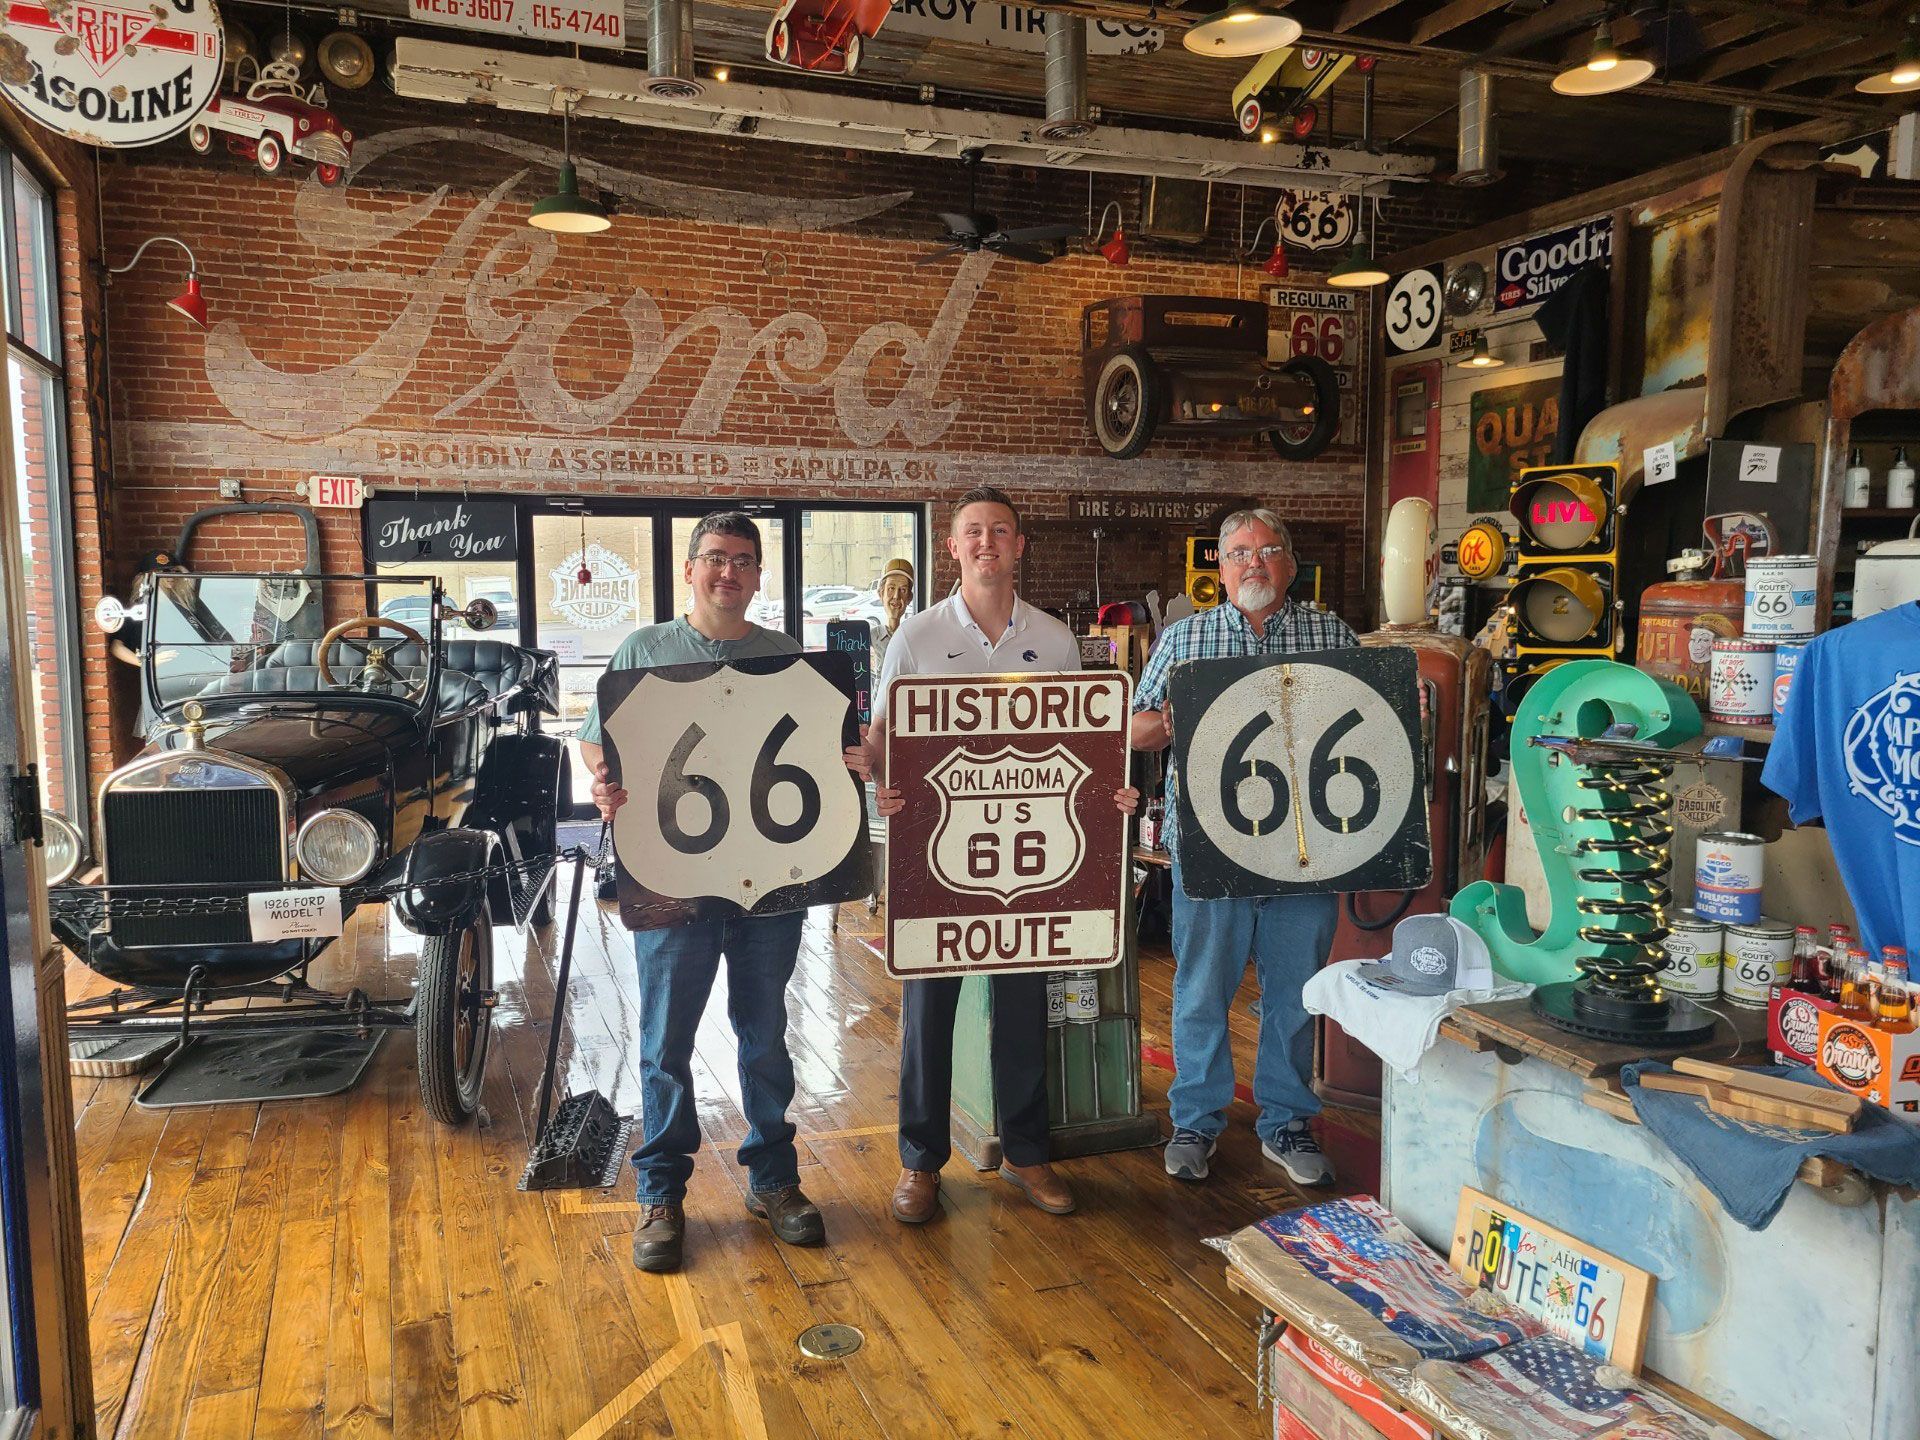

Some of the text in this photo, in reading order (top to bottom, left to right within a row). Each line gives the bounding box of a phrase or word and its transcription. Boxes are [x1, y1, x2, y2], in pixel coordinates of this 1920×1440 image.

[19, 59, 193, 124] ASOLINE
[1291, 202, 1338, 239] 66
[203, 125, 1000, 448] Ford
[1501, 289, 1522, 302] TIRES
[1277, 291, 1348, 309] REGULAR
[1392, 285, 1435, 334] 33
[377, 443, 532, 468] PROUDLY
[548, 449, 729, 475] ASSEMBLED
[318, 478, 356, 506] EXIT
[1078, 501, 1109, 517] TIRE
[1114, 501, 1126, 517] &
[1130, 501, 1190, 518] BATTERY
[379, 504, 472, 548] Thank
[450, 532, 507, 559] You
[1463, 536, 1486, 566] OK
[1758, 584, 1786, 592] ROUTE
[1757, 594, 1787, 613] 66
[830, 629, 869, 652] Thank
[1636, 632, 1682, 665] FUEL
[907, 684, 1112, 733] HISTORIC
[949, 767, 1065, 791] OKLAHOMA
[1220, 708, 1381, 836] 66
[657, 713, 821, 855] 66
[1679, 799, 1722, 813] GASOLINE
[1688, 812, 1711, 821] ALLEY
[967, 830, 1047, 879] 66
[1706, 859, 1732, 867] AMOCO
[264, 896, 325, 909] 1926 FORD
[1698, 890, 1740, 904] TRUCK
[270, 907, 324, 919] MODEL T
[1720, 906, 1743, 917] OIL
[936, 916, 1072, 963] ROUTE
[1665, 942, 1693, 953] ROUTE
[1742, 952, 1770, 960] ROUTE
[1741, 962, 1770, 982] 66
[1051, 998, 1064, 1010] 66
[1080, 994, 1095, 1007] 66
[1789, 1000, 1817, 1013] BOOMER
[1823, 1041, 1882, 1080] Orange
[1467, 1228, 1549, 1307] ROUTE
[1574, 1280, 1607, 1342] 66
